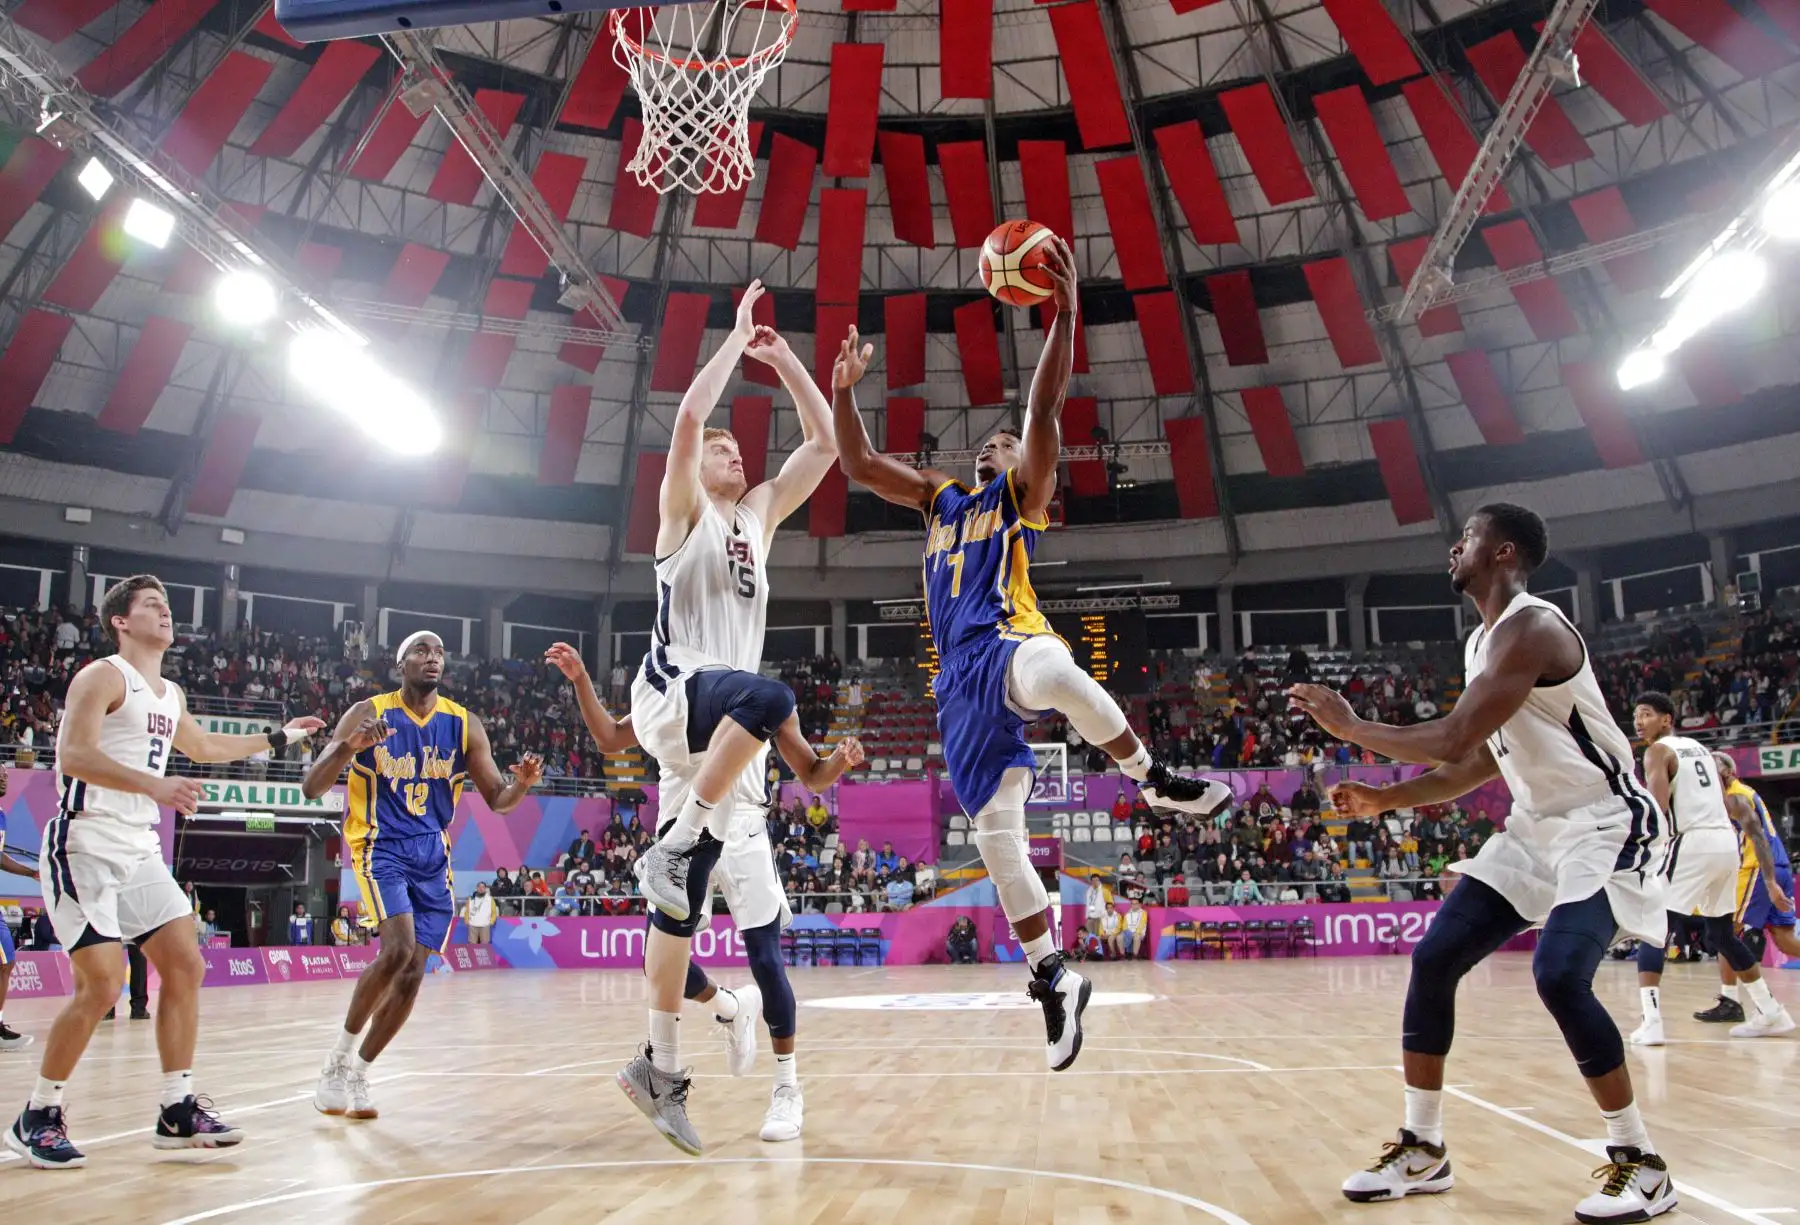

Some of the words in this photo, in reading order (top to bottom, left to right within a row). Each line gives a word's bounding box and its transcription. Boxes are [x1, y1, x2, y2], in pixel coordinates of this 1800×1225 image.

[147, 712, 173, 740] USA
[147, 738, 164, 770] 2
[1694, 760, 1712, 788] 9
[404, 782, 429, 816] 12
[8, 976, 43, 992] PORTS
